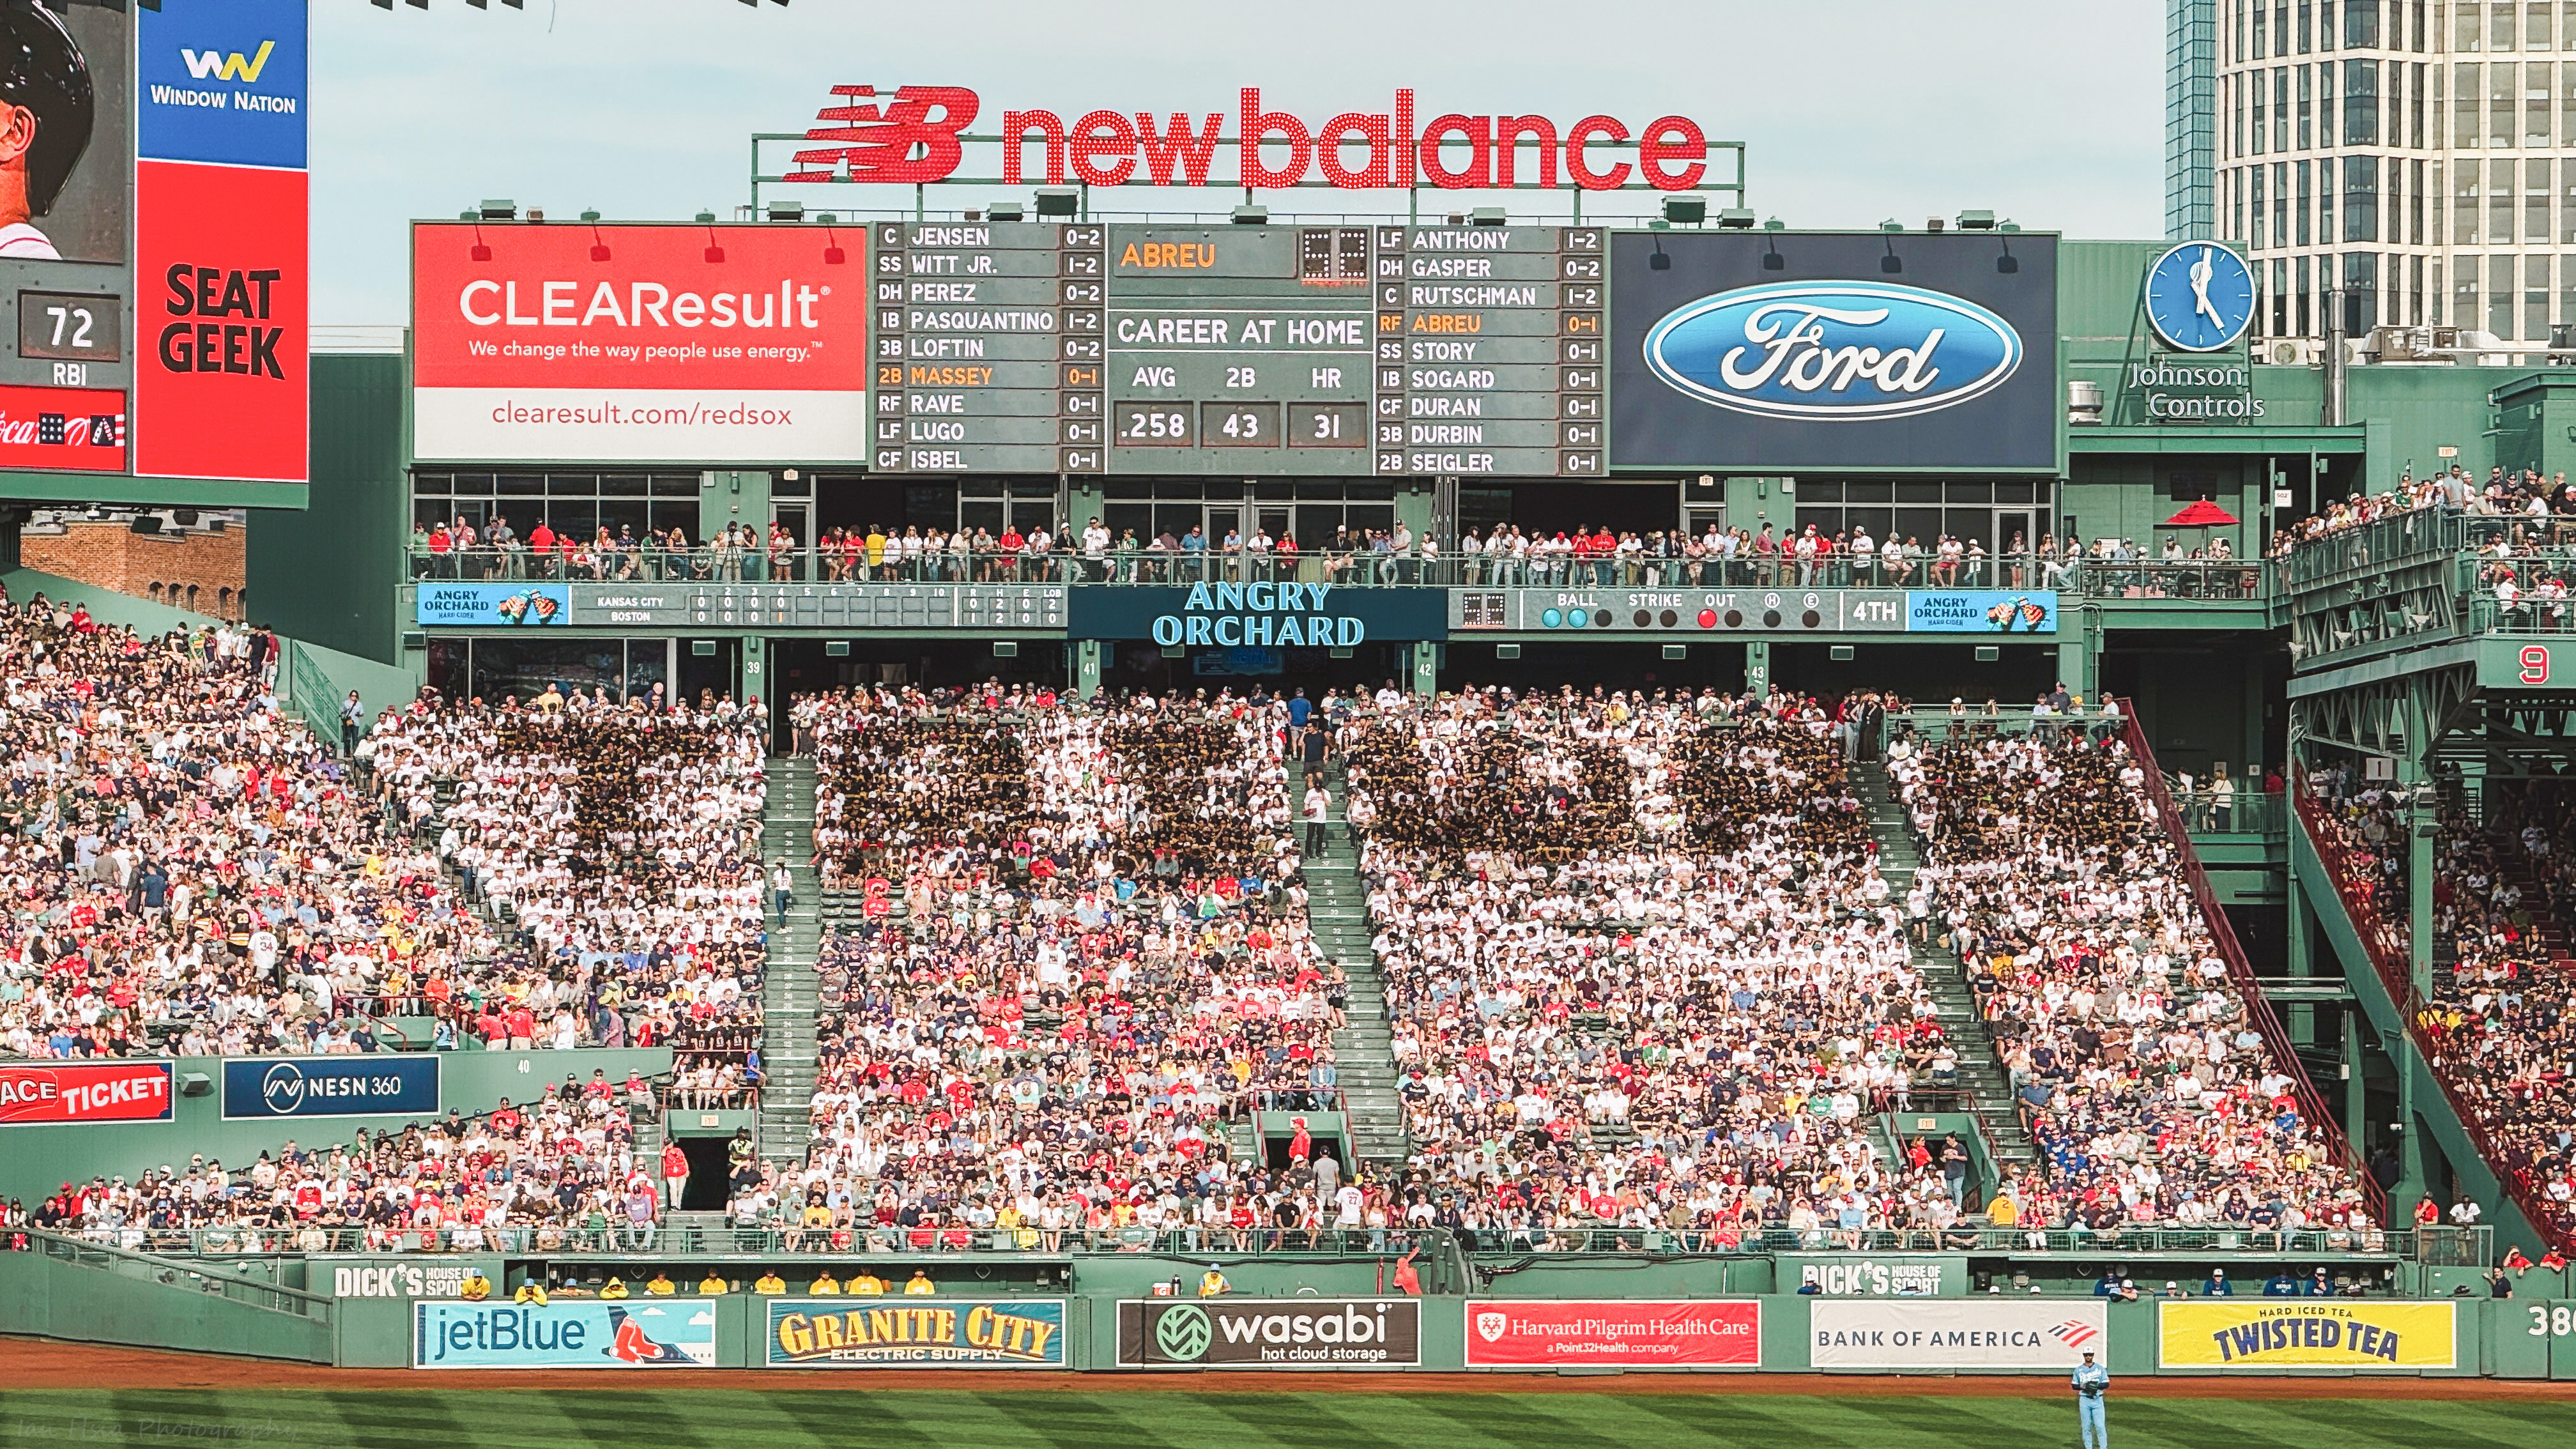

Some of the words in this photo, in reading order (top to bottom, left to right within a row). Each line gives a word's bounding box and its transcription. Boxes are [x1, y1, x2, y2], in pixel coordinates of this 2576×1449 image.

[1004, 108, 1225, 187] new
[1240, 87, 1707, 190] balance
[884, 228, 897, 244] C
[911, 227, 990, 246] JENSEN
[1380, 231, 1402, 248] LF
[1412, 231, 1510, 250] ANTHONY
[880, 256, 901, 272] SS
[911, 255, 959, 273] WITT
[967, 256, 997, 274] JR.
[1120, 242, 1216, 269] ABREU
[1379, 259, 1403, 276] DH
[1412, 258, 1492, 277] GASPER
[167, 264, 280, 319] SEAT
[878, 284, 902, 300] DH
[911, 283, 976, 302] PEREZ
[1385, 288, 1397, 303] C
[1412, 286, 1536, 306] RUTSCHMAN
[47, 307, 93, 348] 72
[911, 311, 1054, 330] PASQUANTINO
[1379, 315, 1401, 332] RF
[1411, 314, 1482, 334] ABREU
[1117, 318, 1228, 344] CAREER
[1240, 319, 1276, 344] AT
[1287, 319, 1364, 344] HOME
[159, 323, 284, 379] GEEK
[468, 341, 498, 356] We
[503, 340, 566, 360] change
[571, 340, 600, 356] the
[605, 346, 640, 362] way
[645, 342, 707, 363] people
[712, 347, 742, 358] use
[880, 339, 902, 356] 3B
[911, 339, 984, 357] LOFTIN
[1380, 343, 1402, 359] SS
[1412, 342, 1476, 361] STORY
[1721, 302, 1946, 394] Ford
[53, 363, 86, 386] RBI
[878, 367, 903, 384] 2B
[910, 367, 992, 387] MASSEY
[1131, 367, 1176, 387] AVG
[1226, 367, 1256, 388] 2B
[1312, 367, 1342, 388] HR
[1412, 370, 1494, 388] SOGARD
[2128, 361, 2243, 388] Johnson
[492, 400, 793, 426] clearesult.com/redsox
[879, 395, 902, 411] RF
[910, 394, 964, 413] RAVE
[1379, 399, 1403, 415] CF
[1411, 397, 1481, 417] DURAN
[2148, 392, 2264, 418] Controls
[879, 423, 901, 439] LF
[911, 422, 965, 441] LUGO
[1121, 413, 1184, 438] .258
[1222, 413, 1259, 438] 43
[1314, 414, 1339, 438] 31
[1380, 426, 1403, 442] 3B
[1411, 425, 1482, 444] DURBIN
[878, 451, 902, 467] CF
[911, 450, 968, 469] ISBEL
[1379, 454, 1402, 470] 2B
[1411, 454, 1494, 472] SEIGLER
[434, 590, 479, 601] ANGRY
[1042, 586, 1064, 598] LOB
[1184, 581, 1332, 611] ANGRY
[1558, 593, 1598, 607] BALL
[1629, 593, 1683, 608] STRIKE
[1705, 593, 1736, 608] OUT
[424, 601, 489, 611] ORCHARD
[597, 597, 638, 607] KANSAS
[640, 597, 664, 608] CITY
[697, 596, 706, 608] 0
[724, 596, 733, 608] 0
[750, 597, 760, 609] 0
[777, 597, 786, 609] 0
[969, 597, 977, 610] 0
[995, 598, 1005, 610] 2
[1853, 601, 1897, 622] 4TH
[1924, 597, 1968, 608] ANGRY
[611, 611, 651, 622] BOSTON
[1914, 608, 1978, 618] ORCHARD
[1152, 615, 1365, 647] ORCHARD
[747, 661, 760, 674] 39
[1084, 661, 1095, 675] 41
[1418, 663, 1432, 677] 42
[1751, 666, 1765, 679] 43
[2519, 645, 2549, 684] 9
[2377, 760, 2383, 778] 1
[518, 1059, 530, 1074] 40
[62, 1077, 167, 1115] TICKET
[310, 1077, 366, 1097] NESN
[371, 1076, 401, 1096] 360
[426, 1267, 461, 1280] HOUSE
[463, 1267, 474, 1280] O
[1891, 1265, 1927, 1278] HOUSE
[1927, 1265, 1942, 1278] OF
[426, 1280, 463, 1296] SPO
[2258, 1307, 2293, 1318] HARD
[2297, 1306, 2326, 1316] ICED
[2330, 1308, 2354, 1318] TEA
[2528, 1306, 2576, 1336] 38
[778, 1307, 958, 1356] GRANITE
[965, 1305, 1058, 1357] CITY
[1218, 1303, 1387, 1344] wasabi
[1512, 1319, 1582, 1336] Harvard
[1584, 1319, 1647, 1340] Pilgrim
[1649, 1319, 1708, 1336] Health
[1708, 1319, 1749, 1336] Care
[434, 1308, 586, 1360] jetBlue
[1818, 1331, 1883, 1346] BANK
[1892, 1331, 1922, 1346] OF
[1929, 1331, 2041, 1347] AMERICA
[2213, 1318, 2340, 1363] TWISTED
[2347, 1321, 2400, 1363] TEA
[830, 1346, 928, 1361] ELECTRIC
[929, 1346, 1004, 1361] SUPPLY
[1261, 1346, 1285, 1360] hot
[1289, 1346, 1328, 1360] cloud
[1331, 1347, 1387, 1362] storage
[1556, 1341, 1629, 1353] Point32Health
[1630, 1344, 1679, 1355] company
